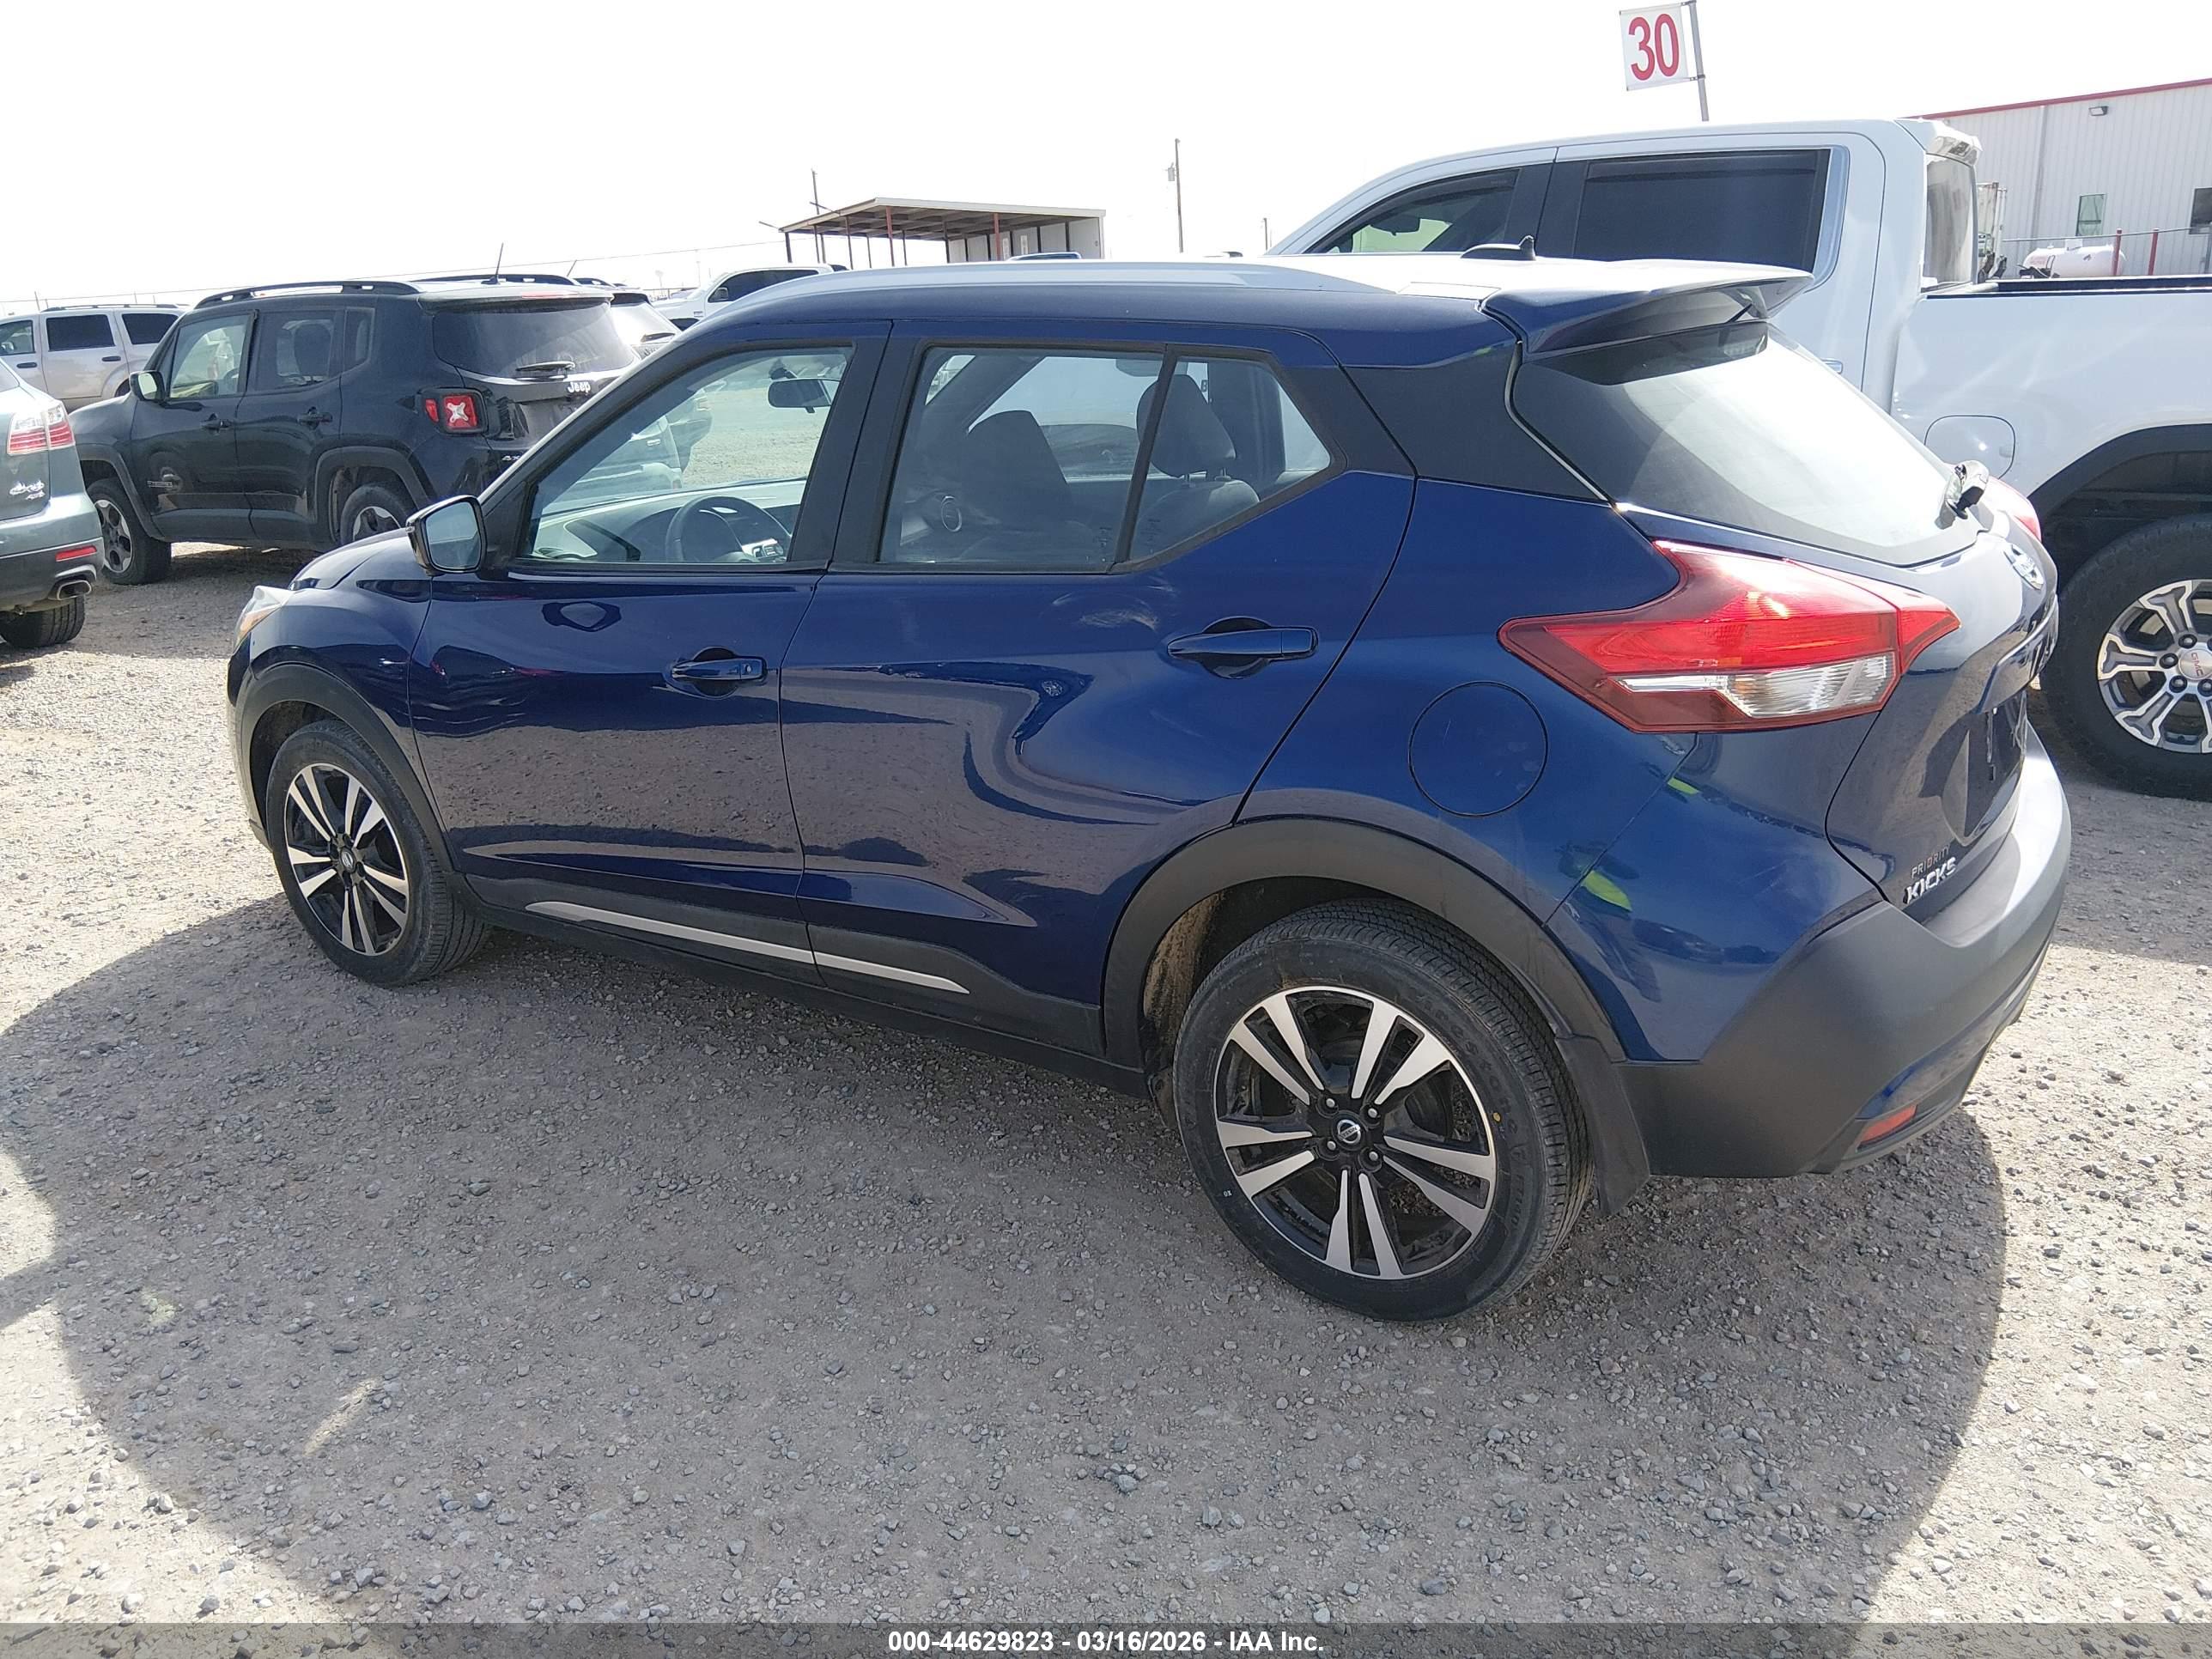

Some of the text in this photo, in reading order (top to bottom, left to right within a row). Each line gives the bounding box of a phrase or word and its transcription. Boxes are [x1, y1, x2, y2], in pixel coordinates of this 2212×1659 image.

[1628, 13, 1680, 81] 30
[567, 381, 591, 393] Jeep
[2191, 652, 2204, 677] GMC
[1904, 856, 1957, 904] KICKS
